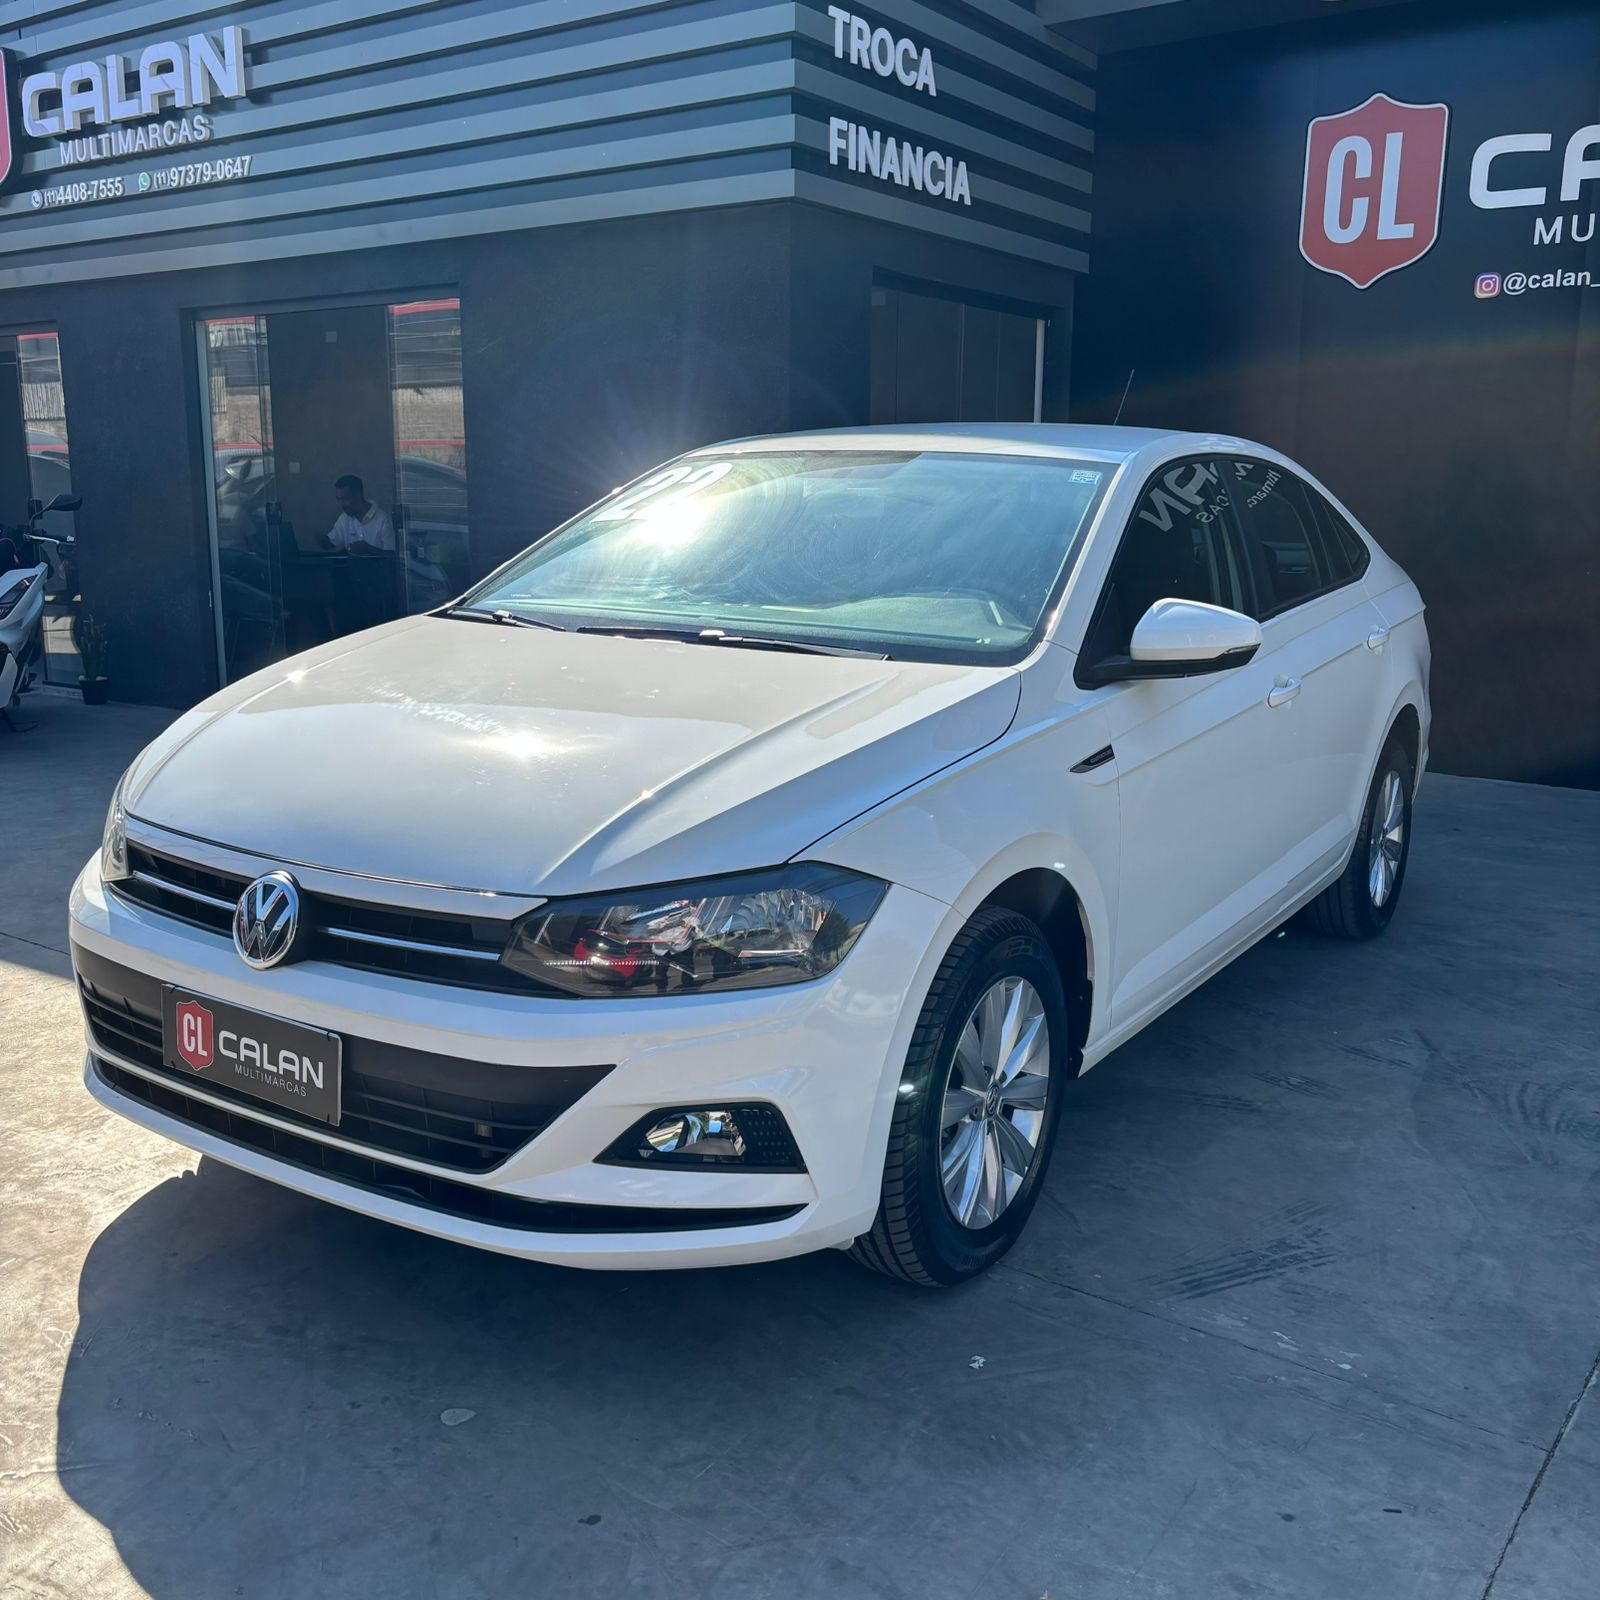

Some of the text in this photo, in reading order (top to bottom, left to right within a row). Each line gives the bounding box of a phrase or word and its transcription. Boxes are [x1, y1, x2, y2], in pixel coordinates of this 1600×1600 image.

[828, 5, 937, 96] TROCA
[21, 25, 246, 137] CALAN
[59, 115, 211, 165] MULTIMARCAS
[829, 116, 971, 206] FINANCIA
[1323, 132, 1415, 244] CL
[1533, 213, 1596, 246] MU
[182, 1012, 208, 1058] CL
[218, 1030, 324, 1089] CALAN
[234, 1062, 308, 1098] MULTIMARCAS
